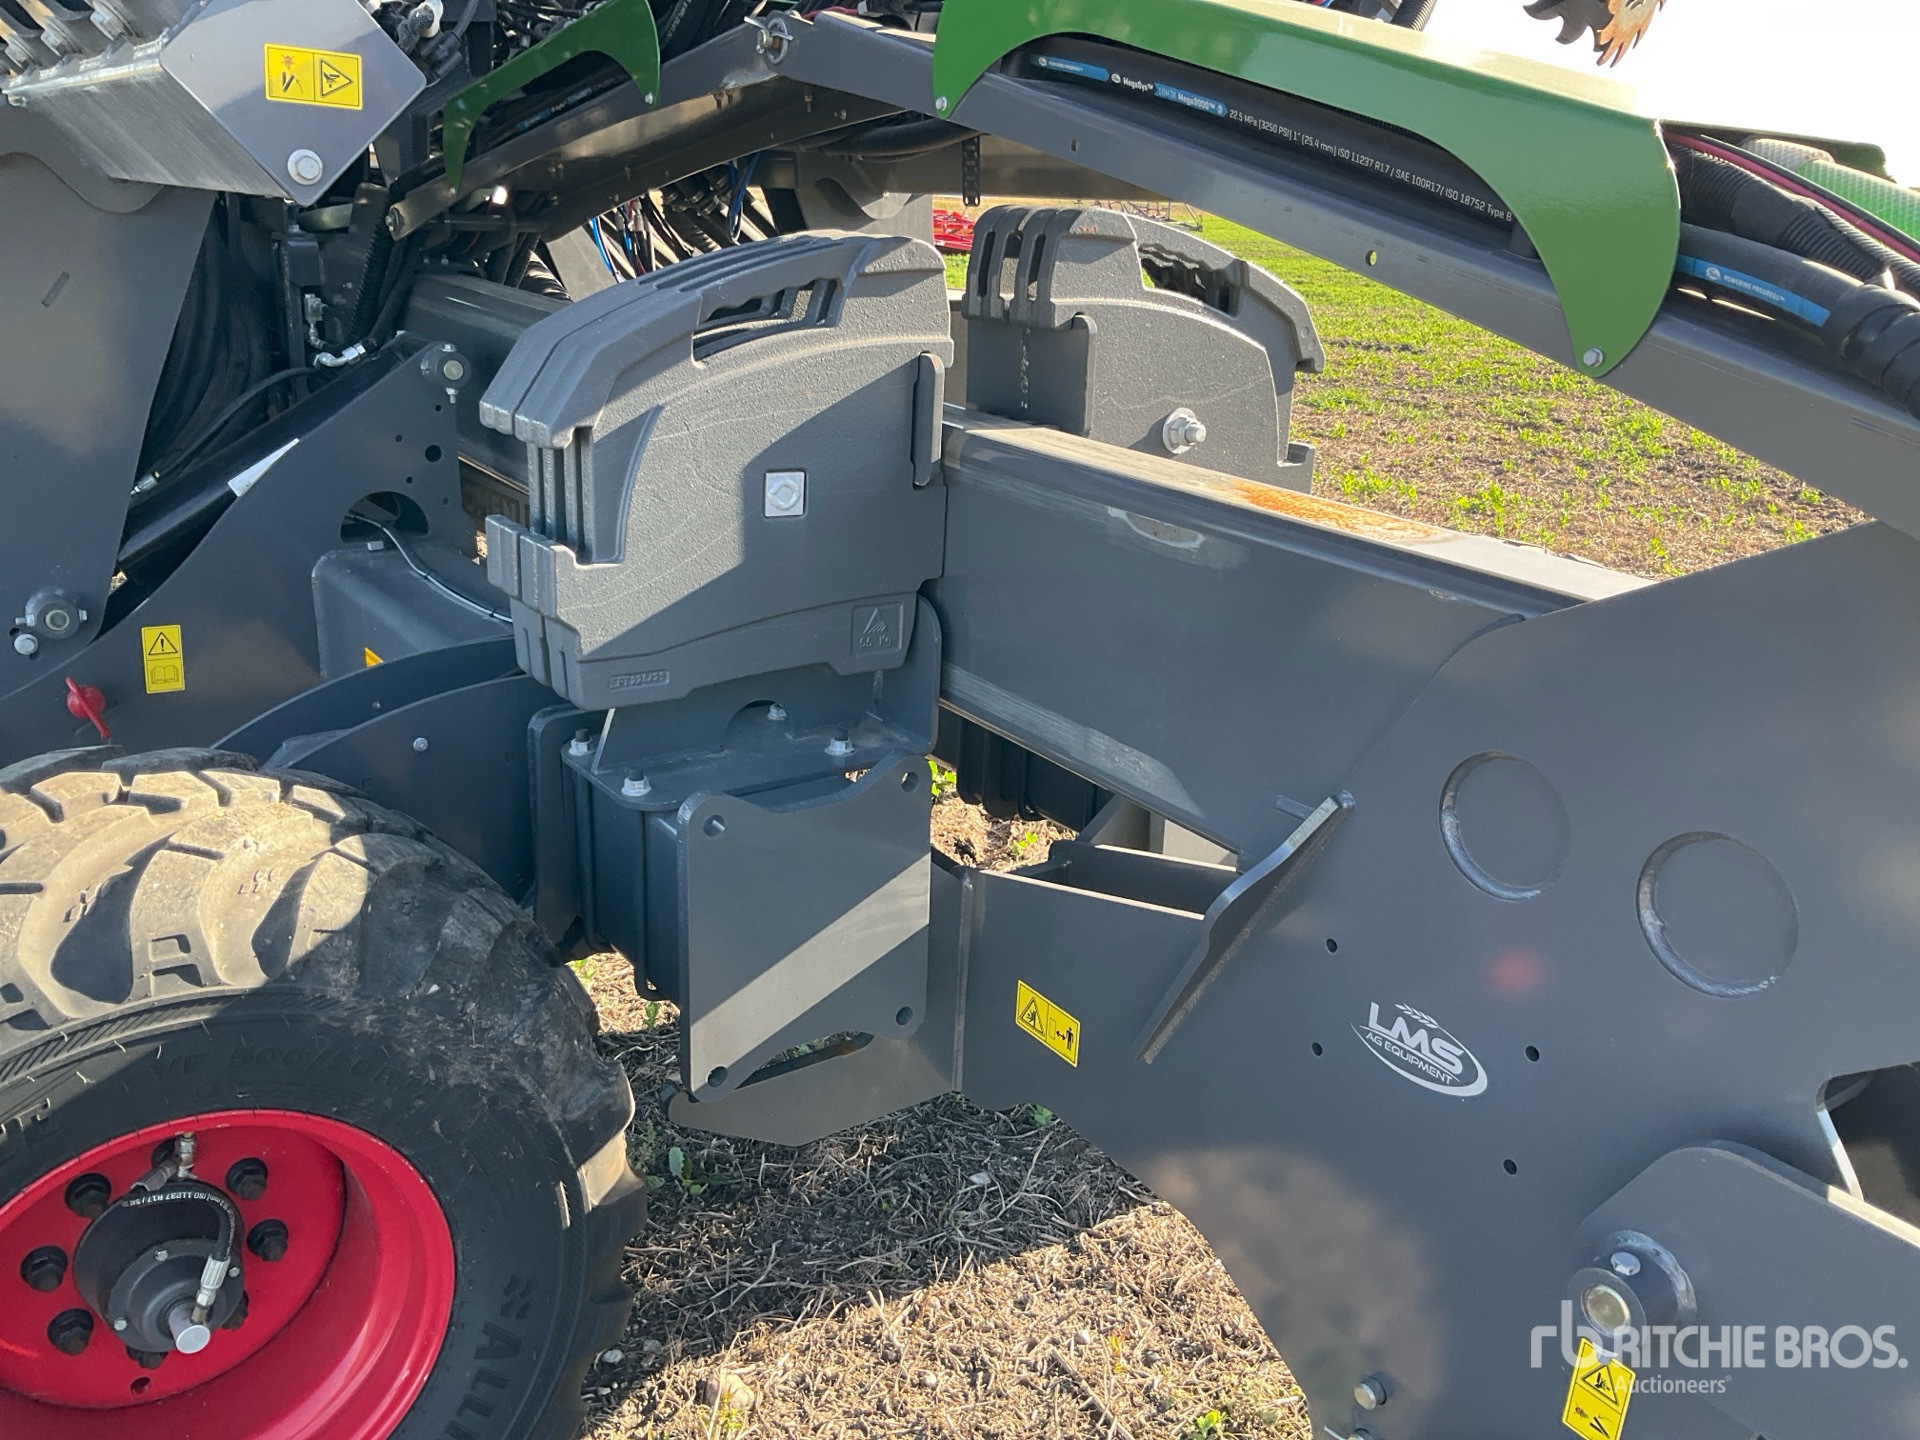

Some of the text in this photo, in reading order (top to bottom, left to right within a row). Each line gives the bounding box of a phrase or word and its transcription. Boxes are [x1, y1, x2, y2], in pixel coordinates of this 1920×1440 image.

[1229, 109, 1243, 122] 22.5
[1244, 114, 1258, 127] MPa
[1338, 147, 1350, 160] ISO
[1351, 152, 1374, 168] 11237
[1374, 161, 1390, 174] R17
[1395, 168, 1411, 182] SAE
[1445, 187, 1458, 201] ISO
[1460, 193, 1486, 212] 18752
[1487, 203, 1505, 219] Type
[1506, 211, 1512, 222] B
[1366, 1031, 1453, 1085] AG EQUIPMENT
[1368, 1001, 1464, 1075] LMS
[147, 1194, 163, 1203] R17
[165, 1191, 192, 1200] 11237
